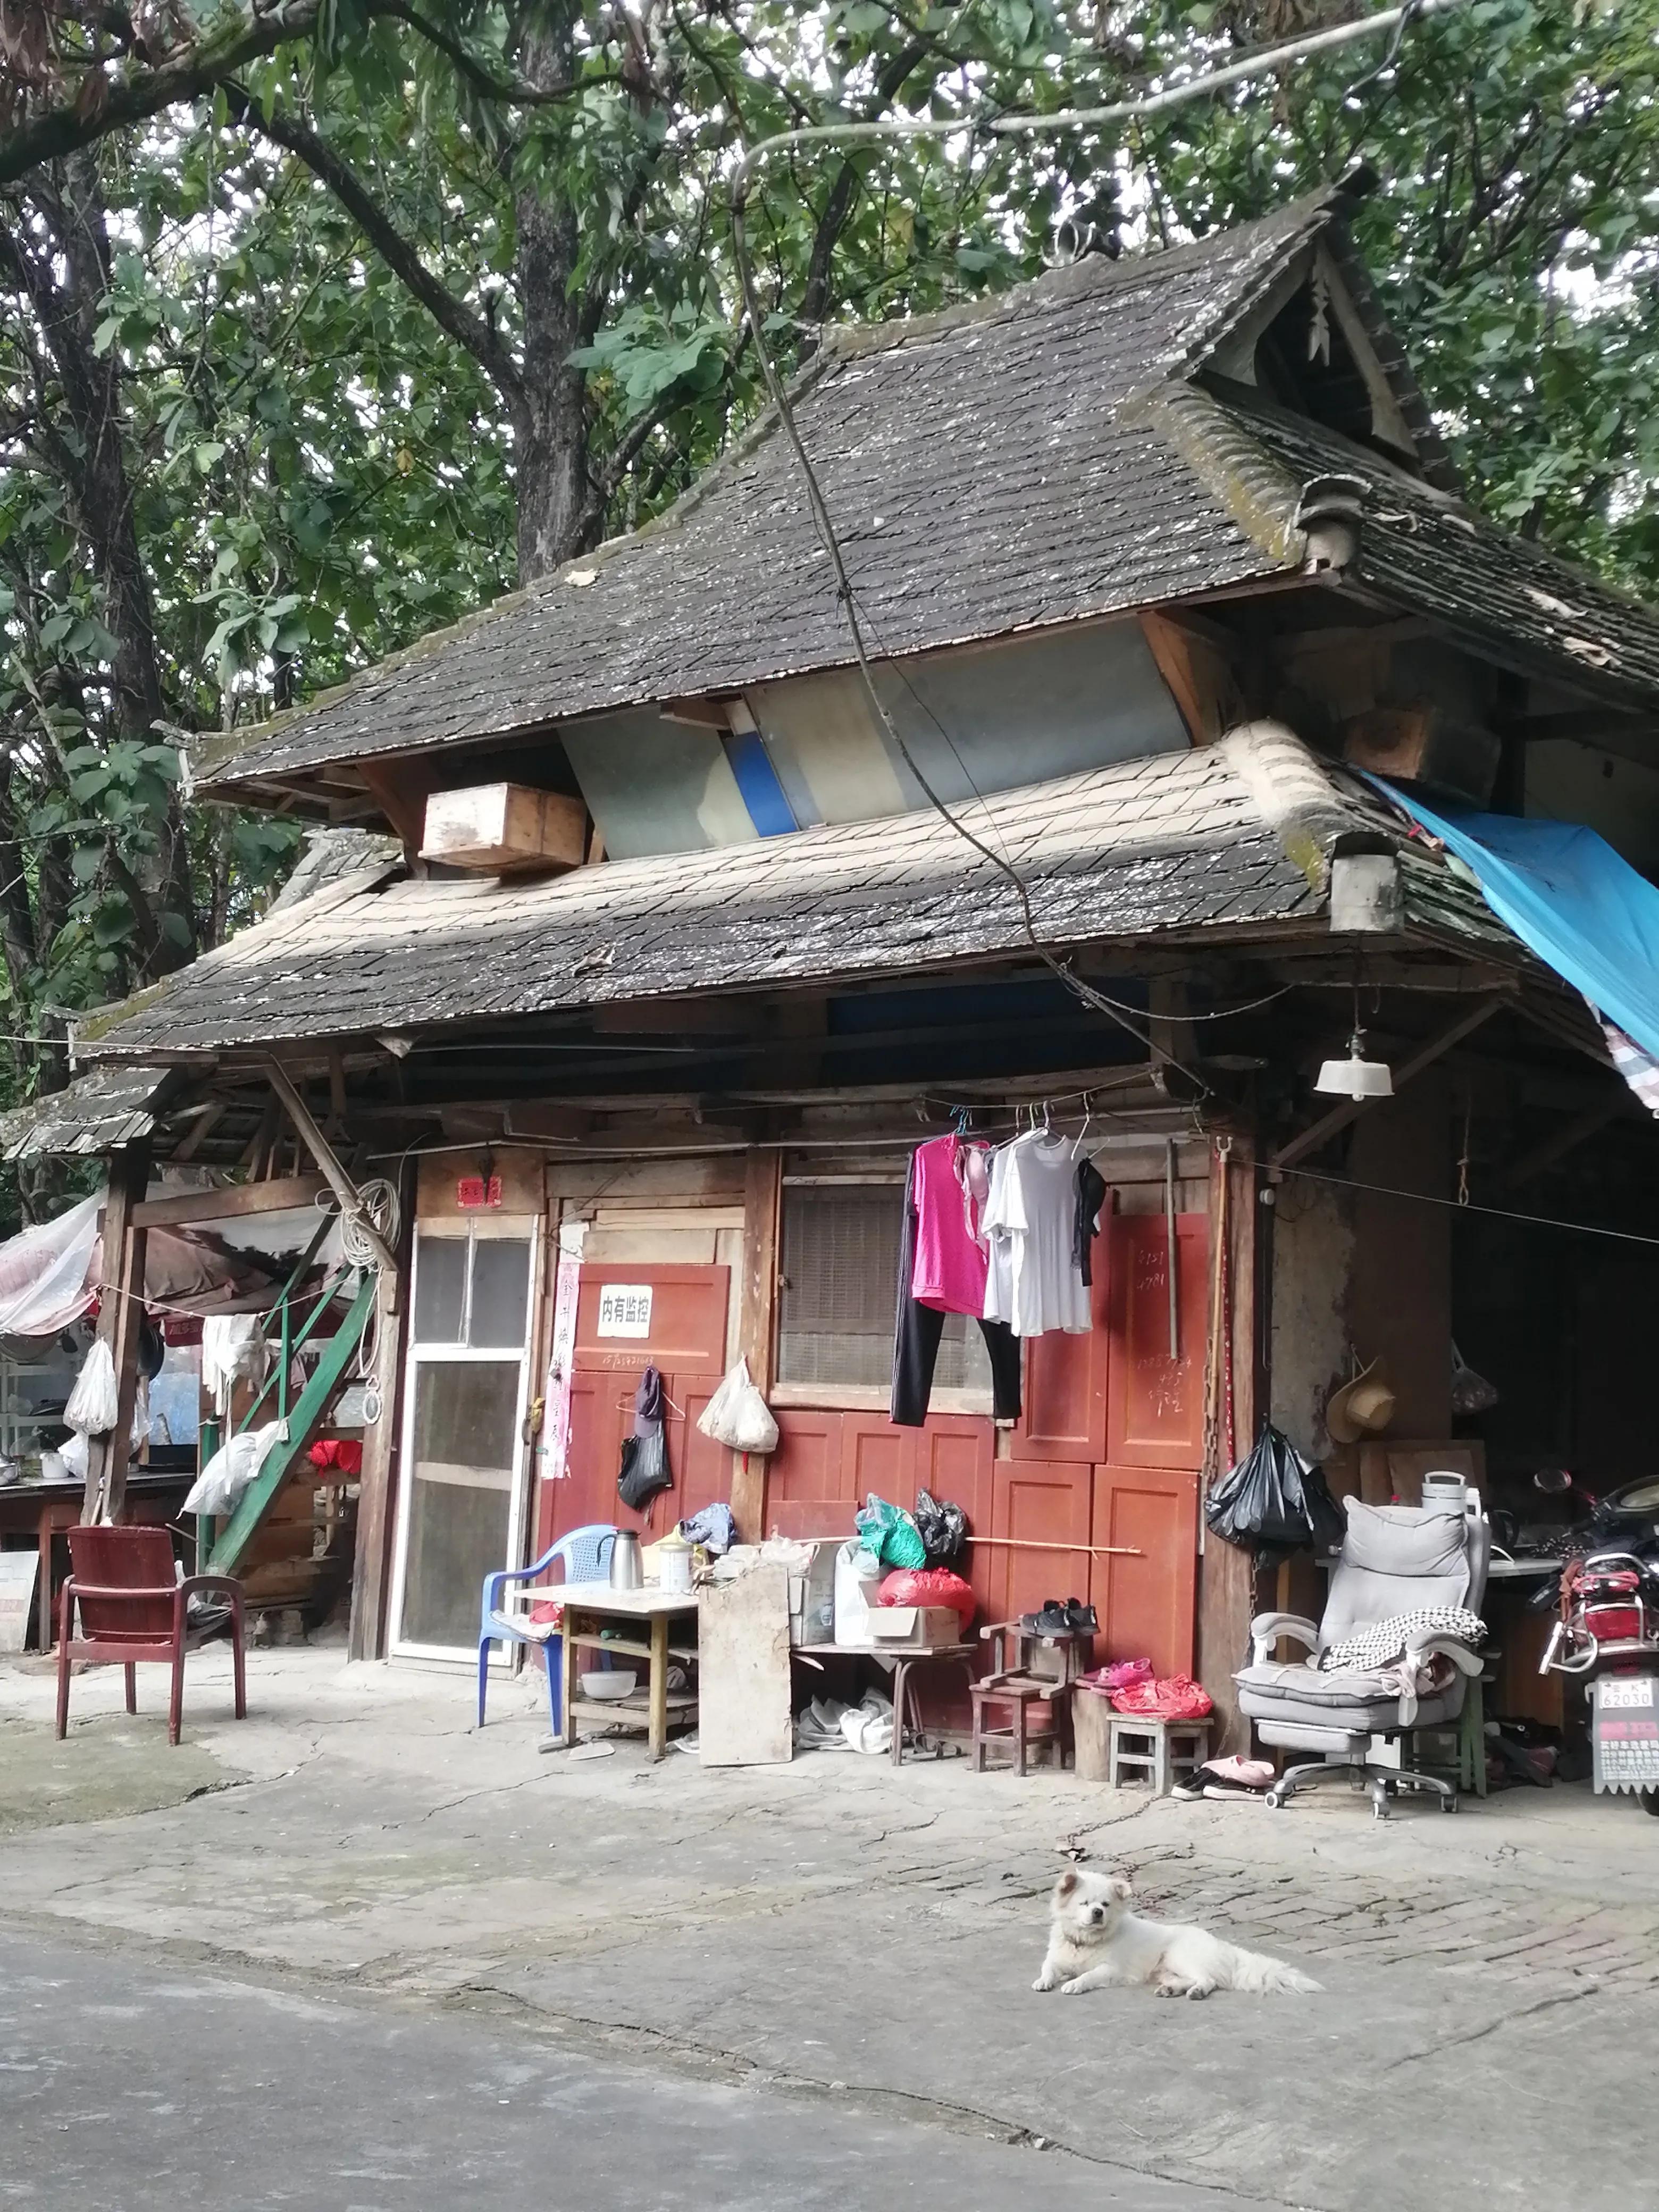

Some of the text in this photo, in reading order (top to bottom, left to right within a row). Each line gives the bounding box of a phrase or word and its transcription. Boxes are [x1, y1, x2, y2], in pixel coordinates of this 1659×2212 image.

[602, 1295, 649, 1323] 内有监控
[1604, 1694, 1649, 1706] 62030
